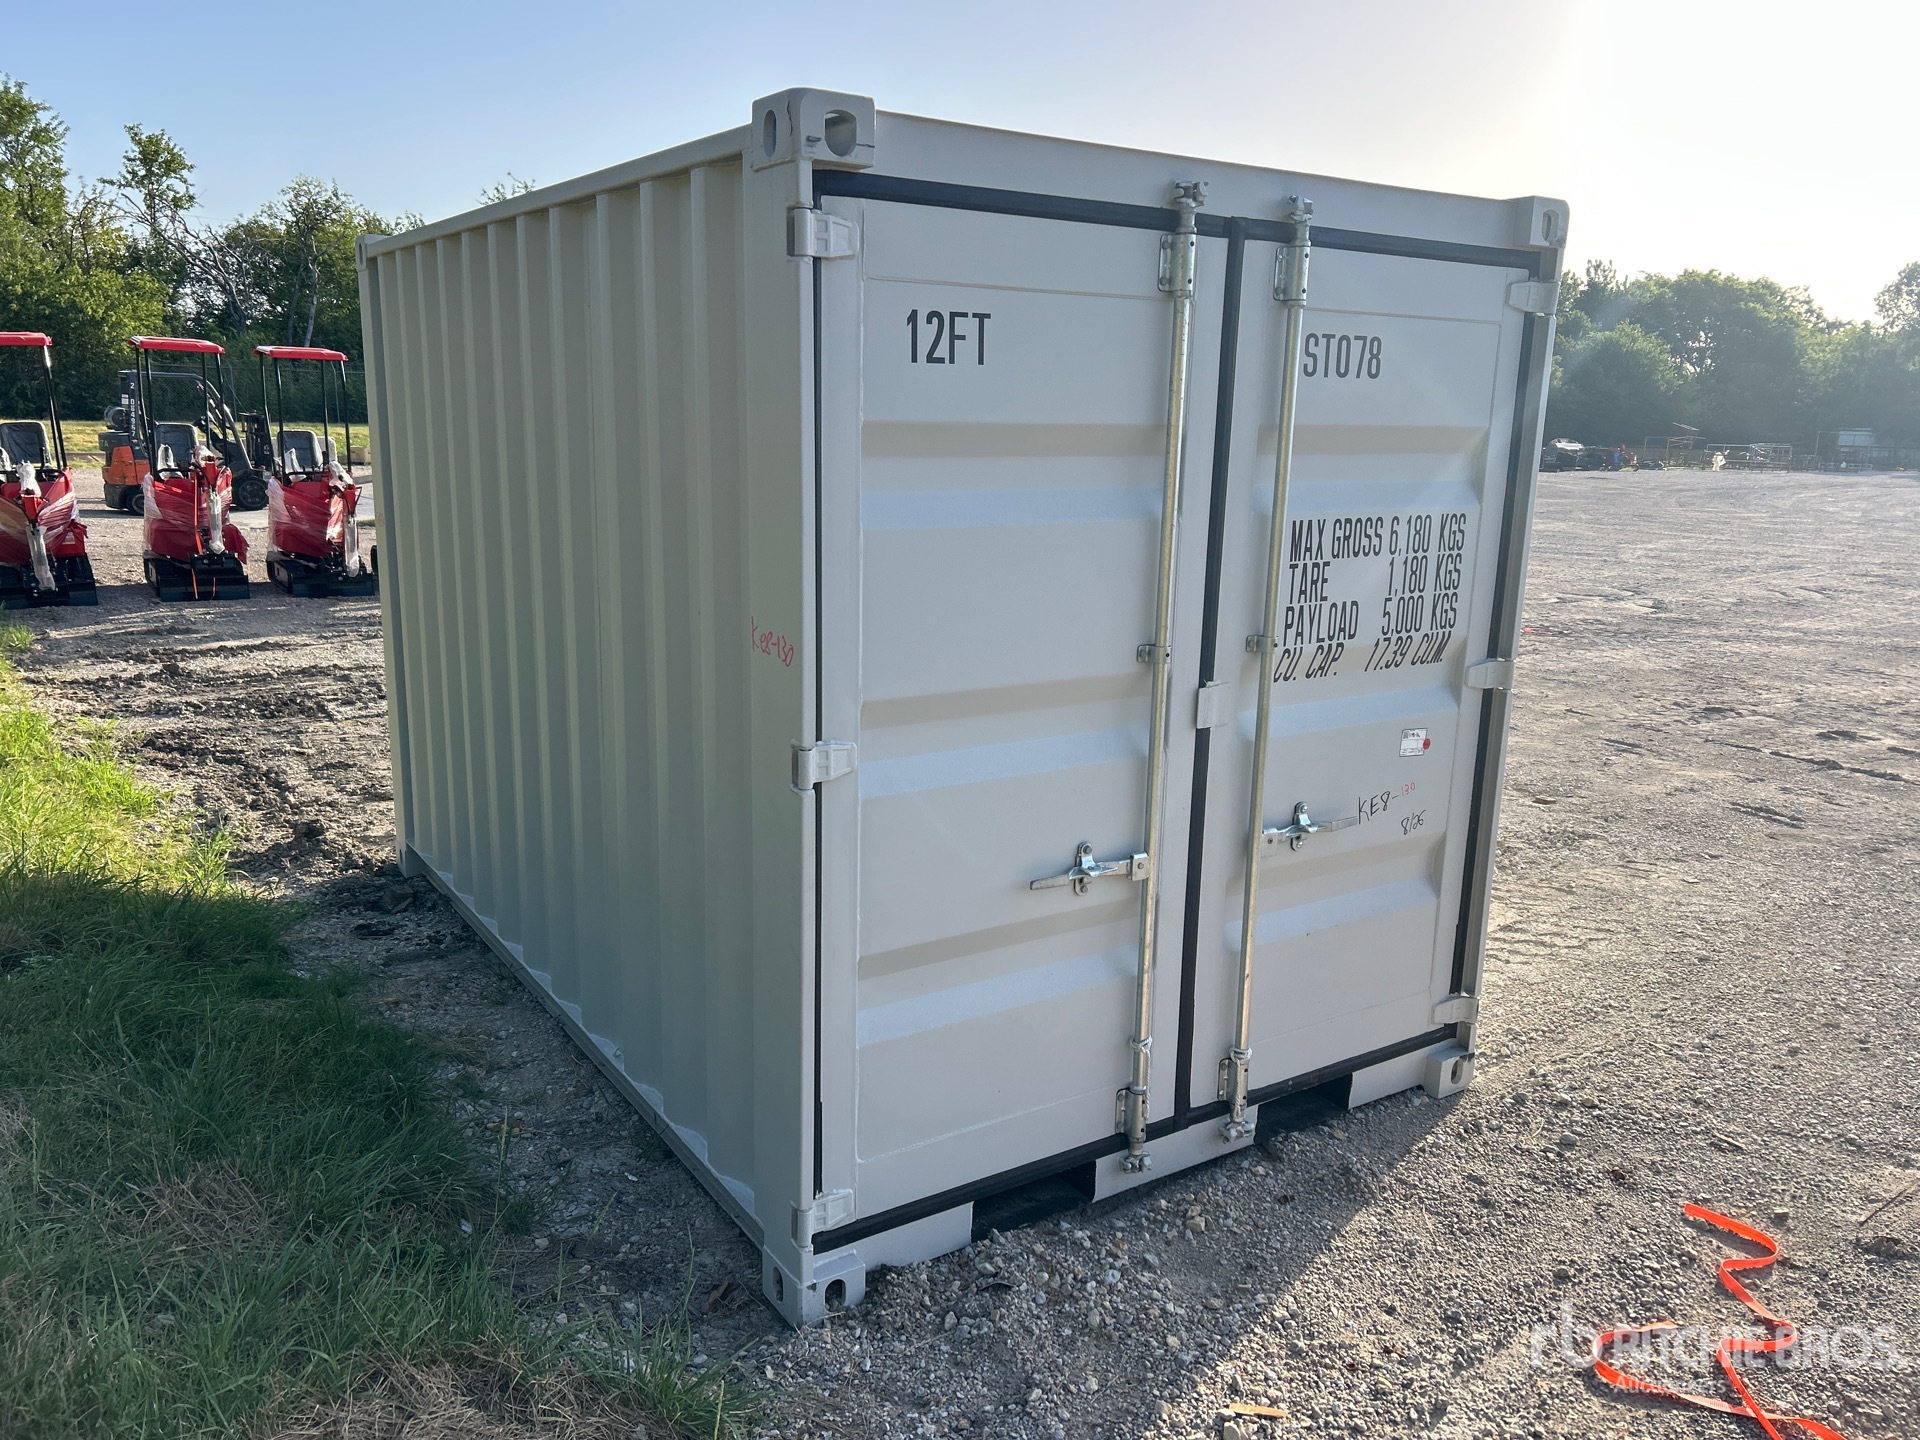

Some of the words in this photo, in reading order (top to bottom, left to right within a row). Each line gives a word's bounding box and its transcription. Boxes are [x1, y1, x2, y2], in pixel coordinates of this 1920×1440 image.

[907, 309, 991, 365] 12FT
[1289, 519, 1326, 562] MAX
[1331, 516, 1384, 559] GROSS
[1389, 514, 1432, 557] 6,180
[1438, 513, 1467, 553] KGS
[1289, 561, 1331, 605] TARE
[1388, 555, 1428, 597] 1,180
[1433, 553, 1462, 592] KGS
[1283, 600, 1359, 647] PAYLOAD
[1381, 594, 1424, 637] 5,000
[1430, 591, 1458, 631] KGS
[1273, 648, 1303, 683] CU.
[1305, 642, 1345, 679] CAP.
[1364, 634, 1413, 672] 17.39
